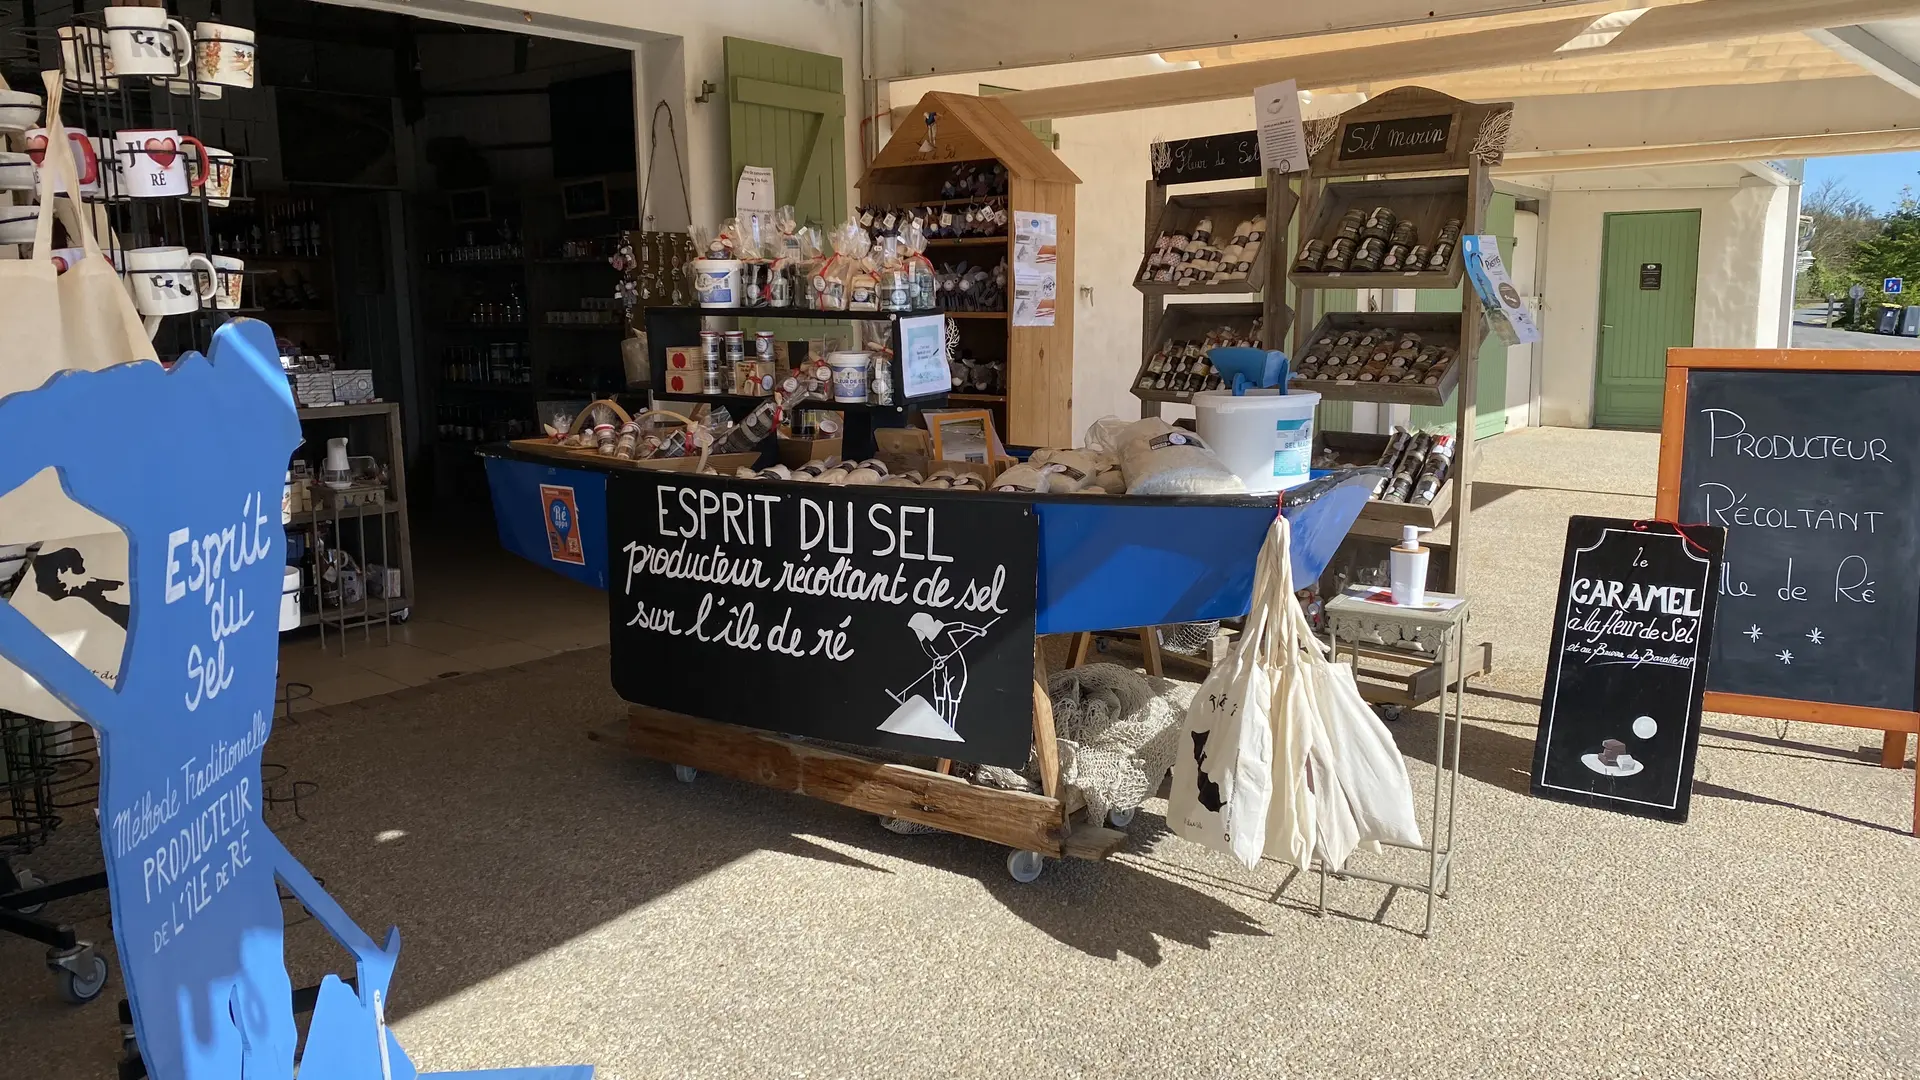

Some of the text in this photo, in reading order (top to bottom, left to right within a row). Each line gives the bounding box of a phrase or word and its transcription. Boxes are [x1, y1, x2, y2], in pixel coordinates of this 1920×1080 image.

[1175, 140, 1208, 174] Fleur
[1214, 151, 1226, 167] de
[1238, 141, 1260, 164] Sel
[1347, 124, 1381, 153] Sel
[150, 171, 167, 186] RÉ
[750, 191, 756, 201] 7
[1701, 408, 1893, 463] PRODUCTEUR
[553, 505, 567, 521] Ré
[657, 485, 954, 563] ESPRIT DU SEL
[1699, 483, 1884, 533] RÉCOLTANT
[165, 491, 271, 605] Esprit
[1633, 547, 1649, 568] le
[623, 539, 1009, 614] producteur récoltant de sel
[1572, 578, 1701, 617] CARAMEL
[1778, 557, 1807, 601] de
[1835, 555, 1876, 603] Ré
[211, 578, 254, 642] du
[626, 592, 855, 662] sur l'île de ré
[1568, 607, 1698, 643] à la fleur de Sel
[185, 639, 234, 712] Sel
[1566, 642, 1580, 652] et
[1580, 646, 1592, 654] au
[1626, 649, 1640, 660] de
[113, 709, 268, 859] Méthode Traditionnelle
[143, 776, 252, 904] PRODUCTEUR
[154, 820, 252, 954] DE L'ÎLE DE RÉ
